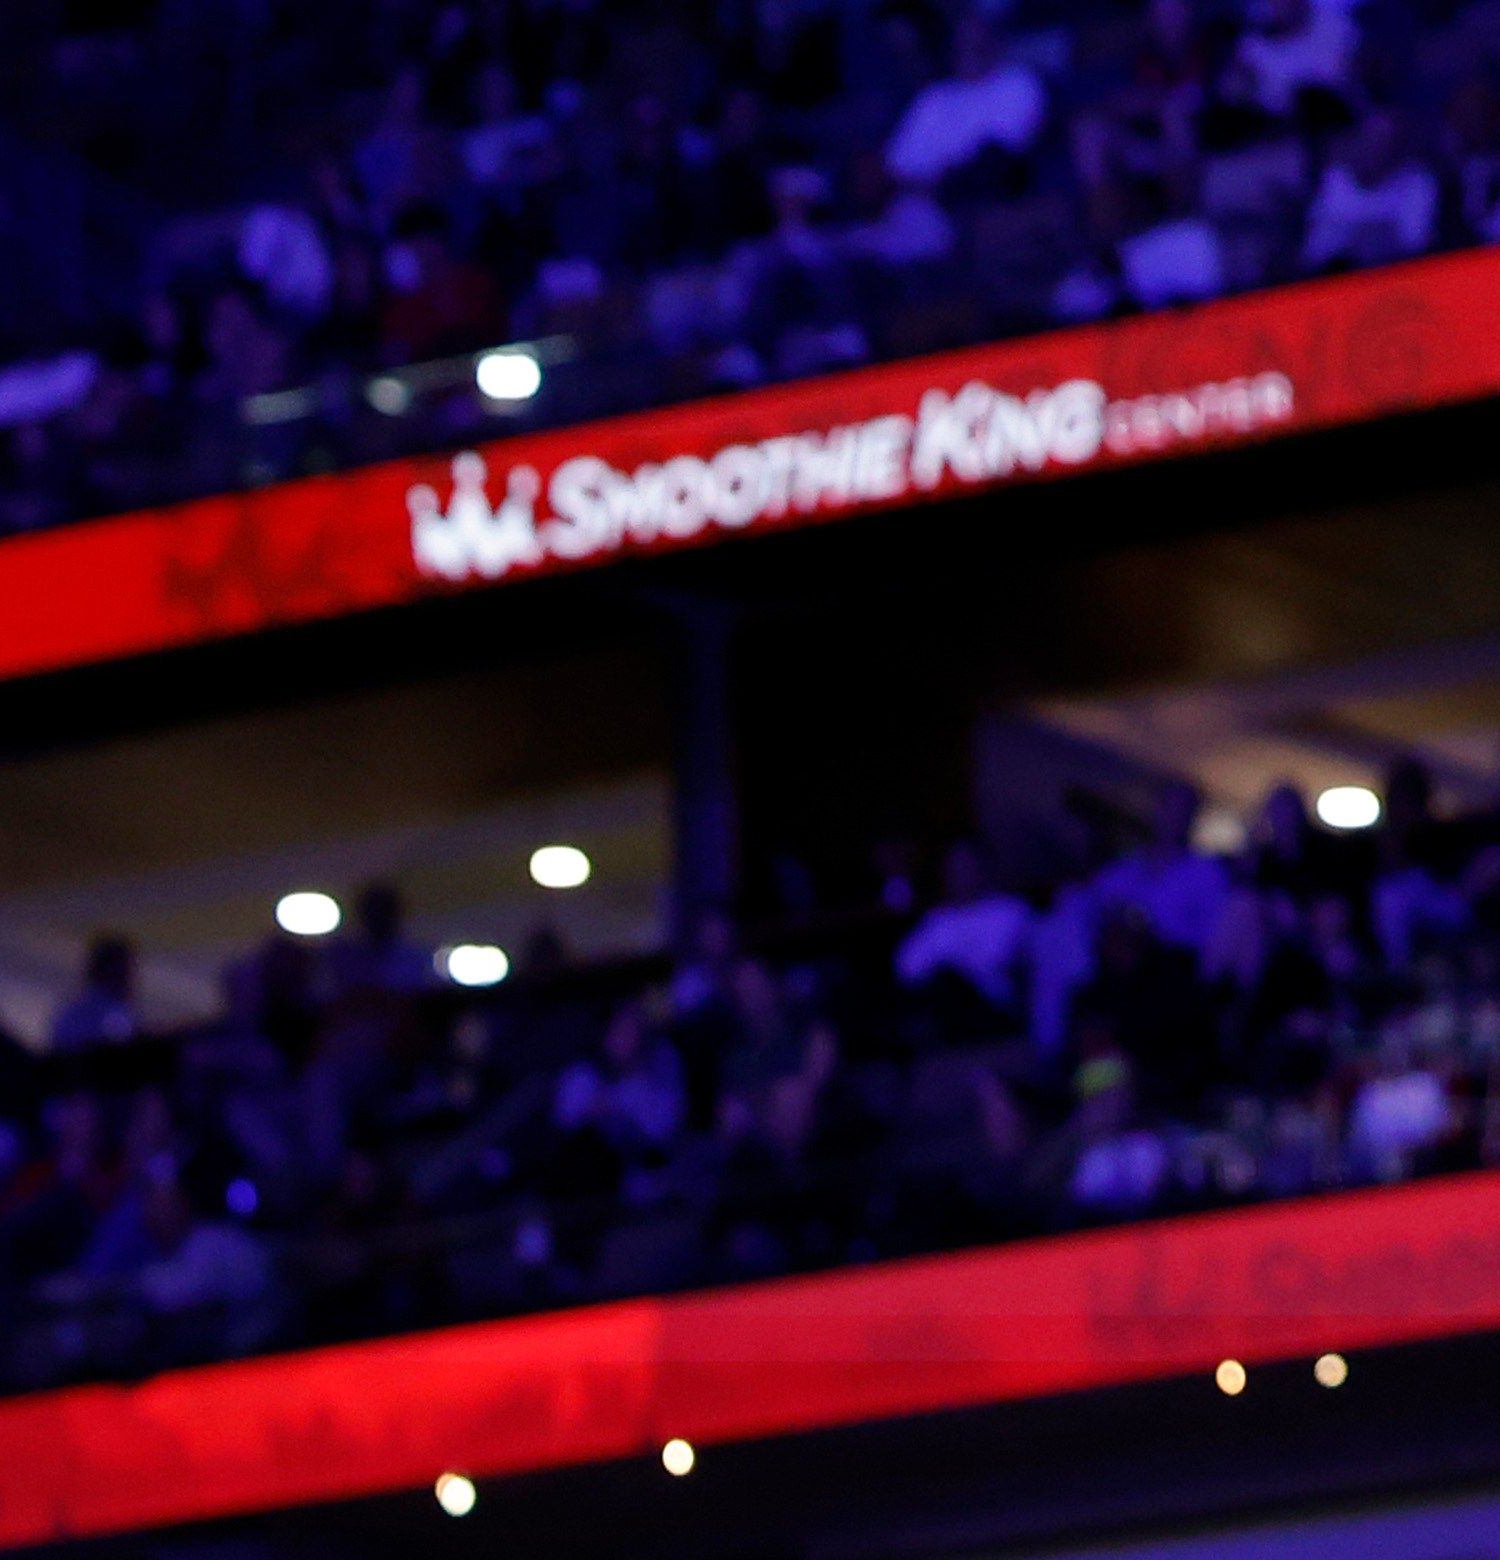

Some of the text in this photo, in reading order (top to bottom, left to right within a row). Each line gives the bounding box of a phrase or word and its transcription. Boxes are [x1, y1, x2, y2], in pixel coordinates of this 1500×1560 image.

[541, 371, 1296, 559] SMOOTHIE KING CENTER
